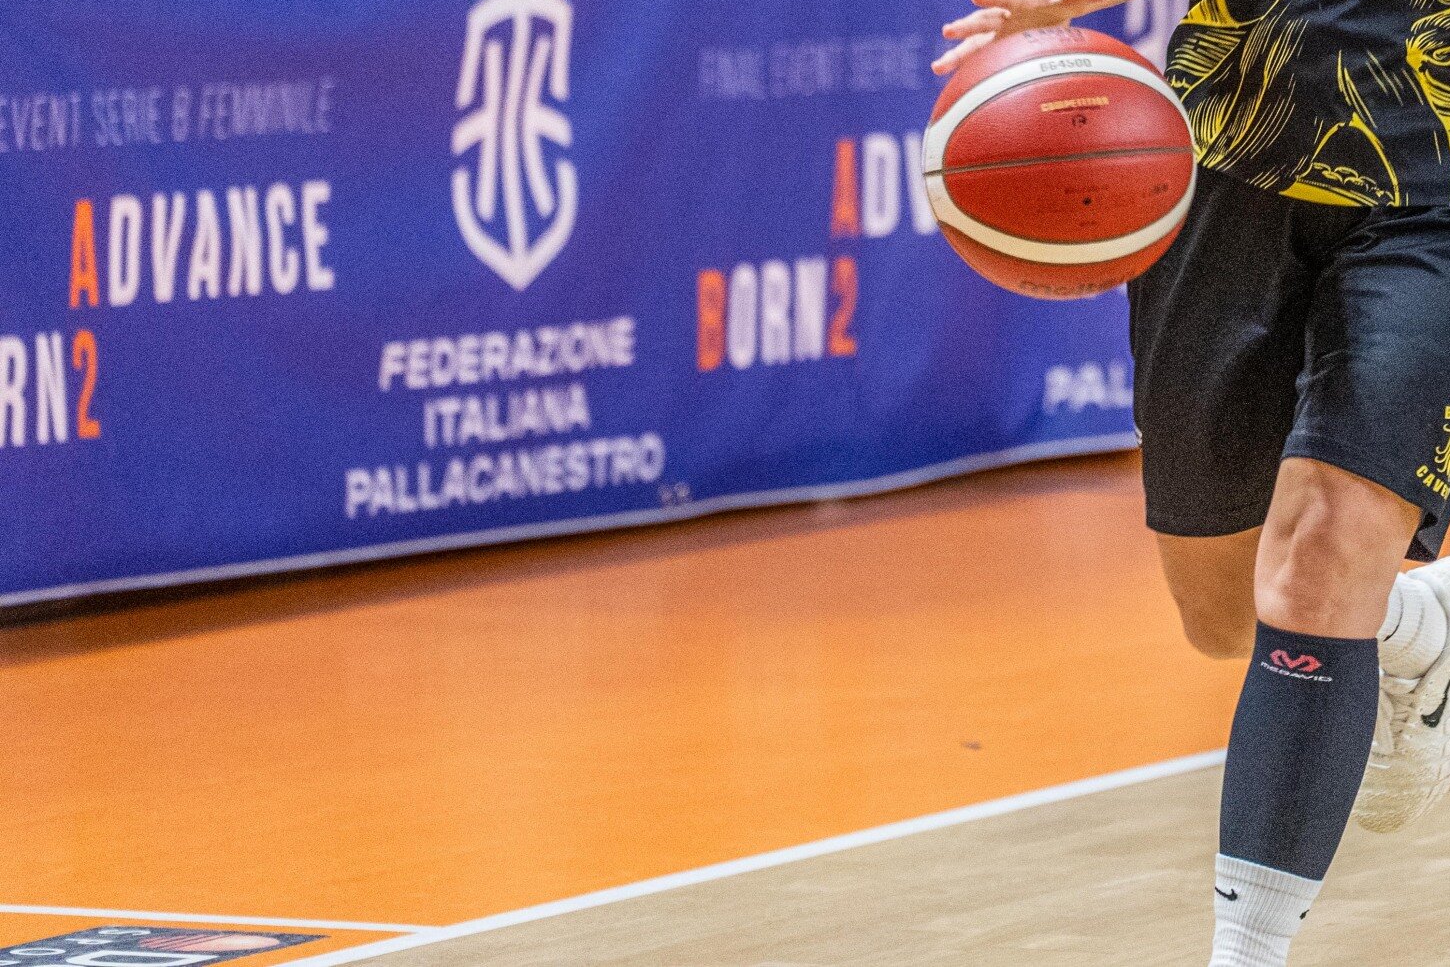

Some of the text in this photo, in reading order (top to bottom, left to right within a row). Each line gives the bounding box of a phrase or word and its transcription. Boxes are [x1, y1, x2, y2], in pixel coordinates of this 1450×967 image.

[92, 89, 162, 148] SERIE
[69, 180, 335, 308] ADVANCE
[696, 254, 859, 371] BORN2
[378, 317, 635, 393] FEDERAZIONE
[423, 383, 591, 449] ITALIANA
[344, 431, 666, 520] PALLACANESTRO
